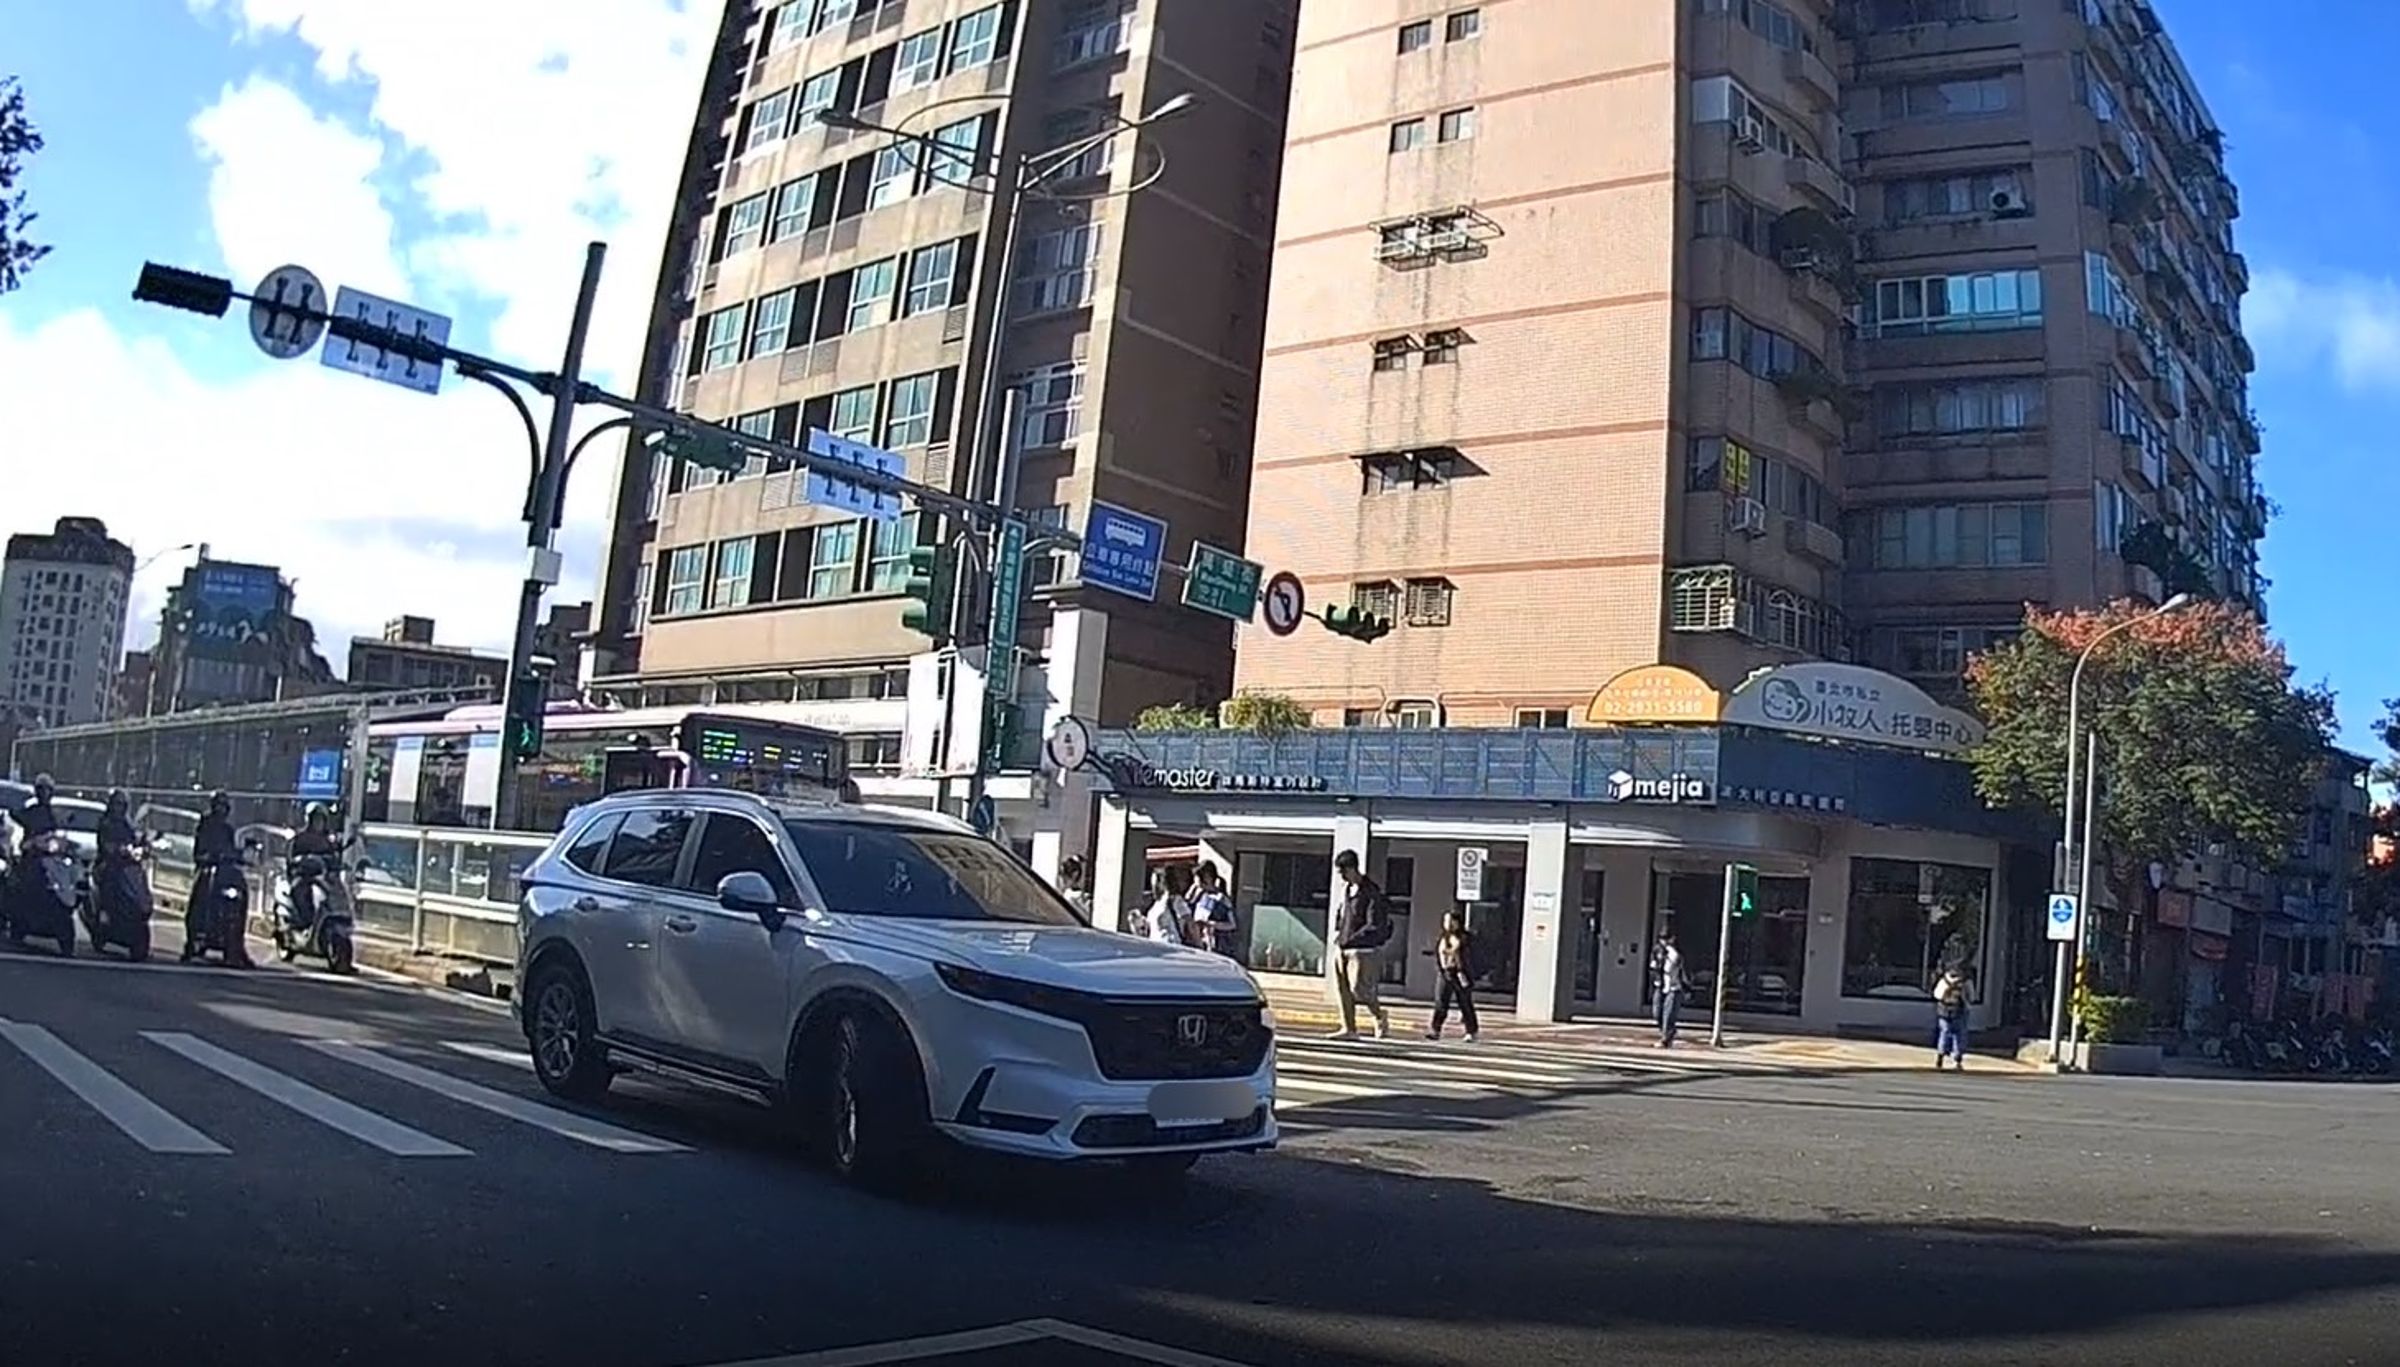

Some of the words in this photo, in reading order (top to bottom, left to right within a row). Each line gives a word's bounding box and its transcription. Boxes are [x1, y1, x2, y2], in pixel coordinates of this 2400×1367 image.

[1812, 699, 1883, 733] 小牧人
[1892, 712, 1973, 745] 托嬰中心
[1634, 773, 1703, 803] mejia
